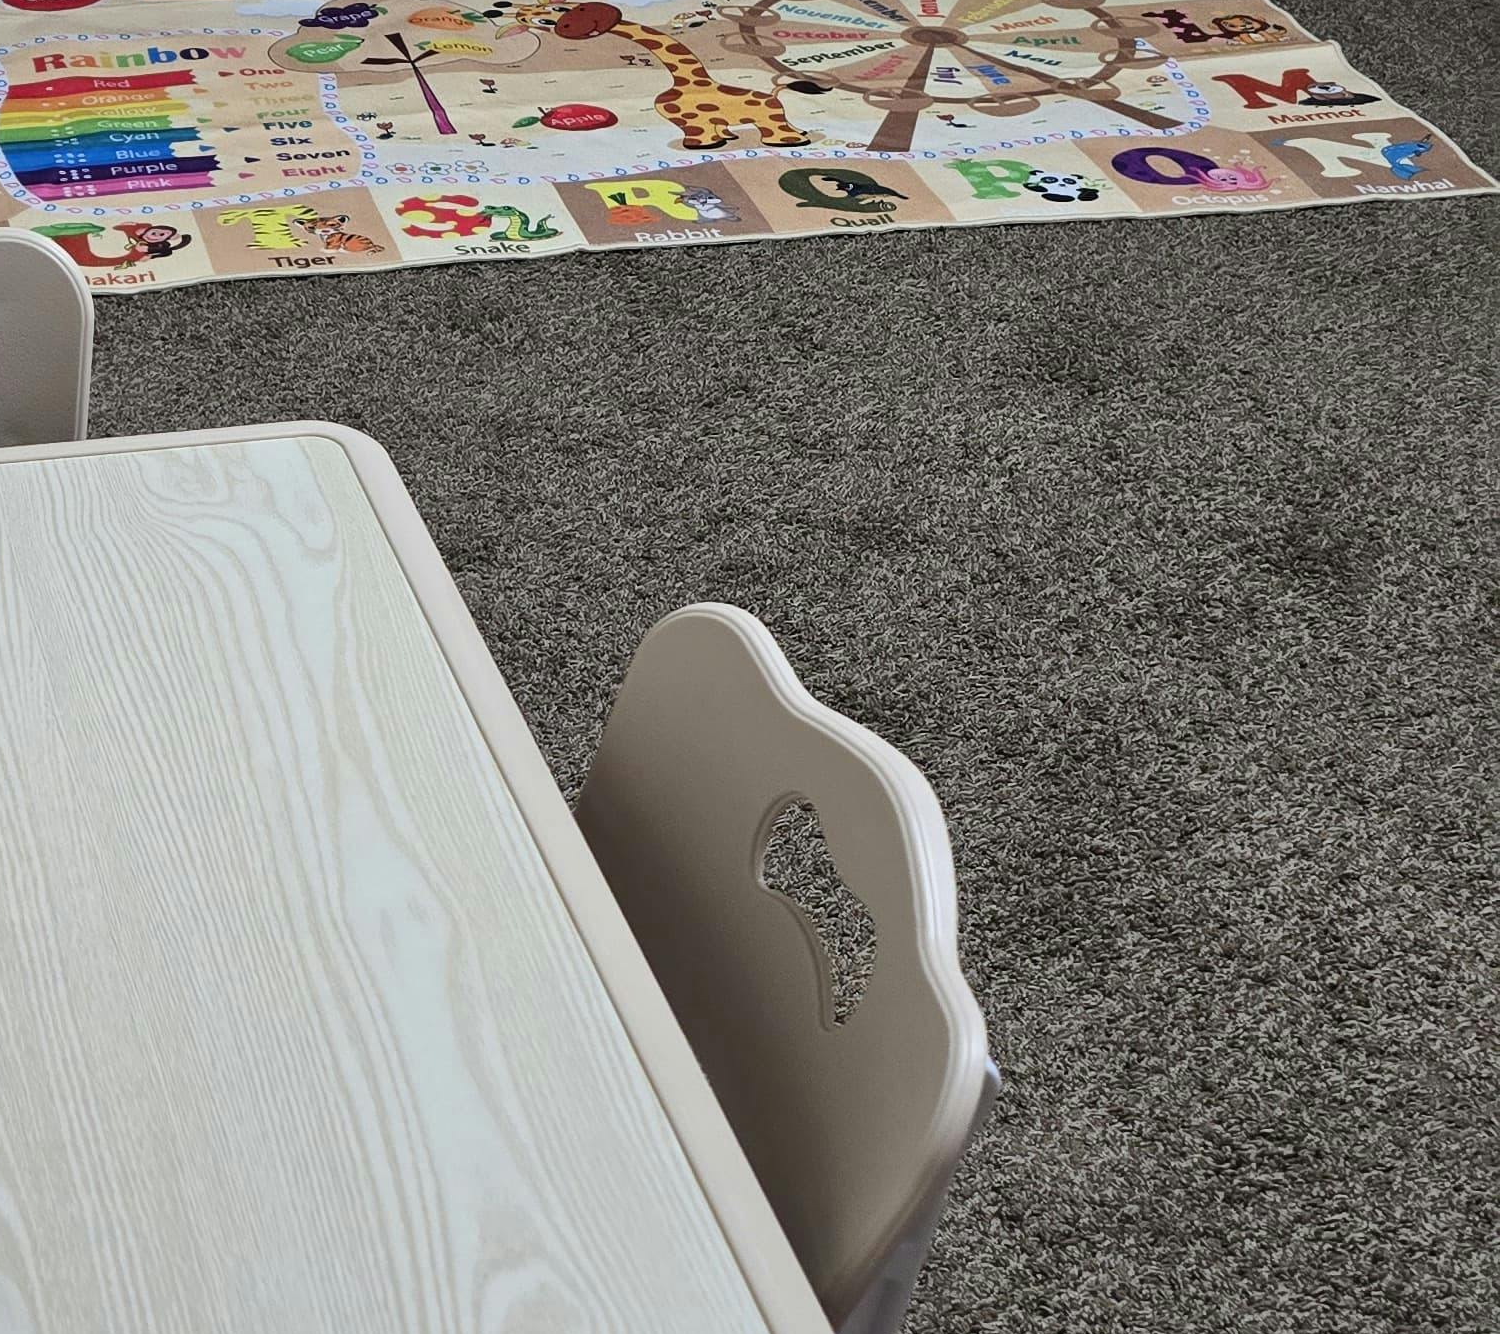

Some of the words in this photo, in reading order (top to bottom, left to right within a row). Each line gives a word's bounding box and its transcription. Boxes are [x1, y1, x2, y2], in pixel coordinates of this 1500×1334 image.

[317, 8, 374, 24] Grape
[409, 14, 476, 27] Orange
[776, 3, 891, 30] November
[990, 14, 1060, 33] March
[772, 29, 870, 41] October
[1012, 35, 1081, 49] April
[303, 41, 346, 60] Pear
[431, 41, 493, 54] Lemon
[782, 40, 897, 68] September
[32, 46, 247, 73] Rainbow
[1003, 49, 1063, 67] May
[239, 68, 286, 77] One
[932, 66, 964, 86] July
[972, 63, 1012, 87] June
[93, 78, 131, 89] Red
[244, 80, 294, 91] Two
[1212, 68, 1324, 109] M
[81, 91, 156, 105] Orange
[252, 94, 315, 106] Three
[97, 105, 158, 117] Yellow
[256, 108, 311, 119] Four
[1268, 108, 1367, 125] Marmot
[97, 119, 159, 129] Green
[262, 120, 313, 131] Five
[551, 113, 606, 128] Apple
[109, 132, 160, 143] Cyan
[270, 136, 314, 146] Six
[116, 148, 161, 160] Blue
[275, 149, 351, 161] Seven
[1282, 132, 1395, 178] N
[110, 161, 178, 176] Purple
[281, 164, 347, 177] Eight
[1111, 147, 1220, 186] O
[126, 178, 172, 190] Pink
[942, 157, 1034, 200] P
[778, 168, 898, 212] Q
[1356, 178, 1456, 195] Narwhal
[584, 180, 700, 221] R
[1171, 193, 1269, 208] Octopus
[395, 194, 492, 239] S
[830, 213, 896, 228] Quail
[217, 204, 318, 249] T
[635, 225, 724, 244] Rabbit
[453, 241, 531, 257] Snake
[268, 254, 336, 269] Tiger
